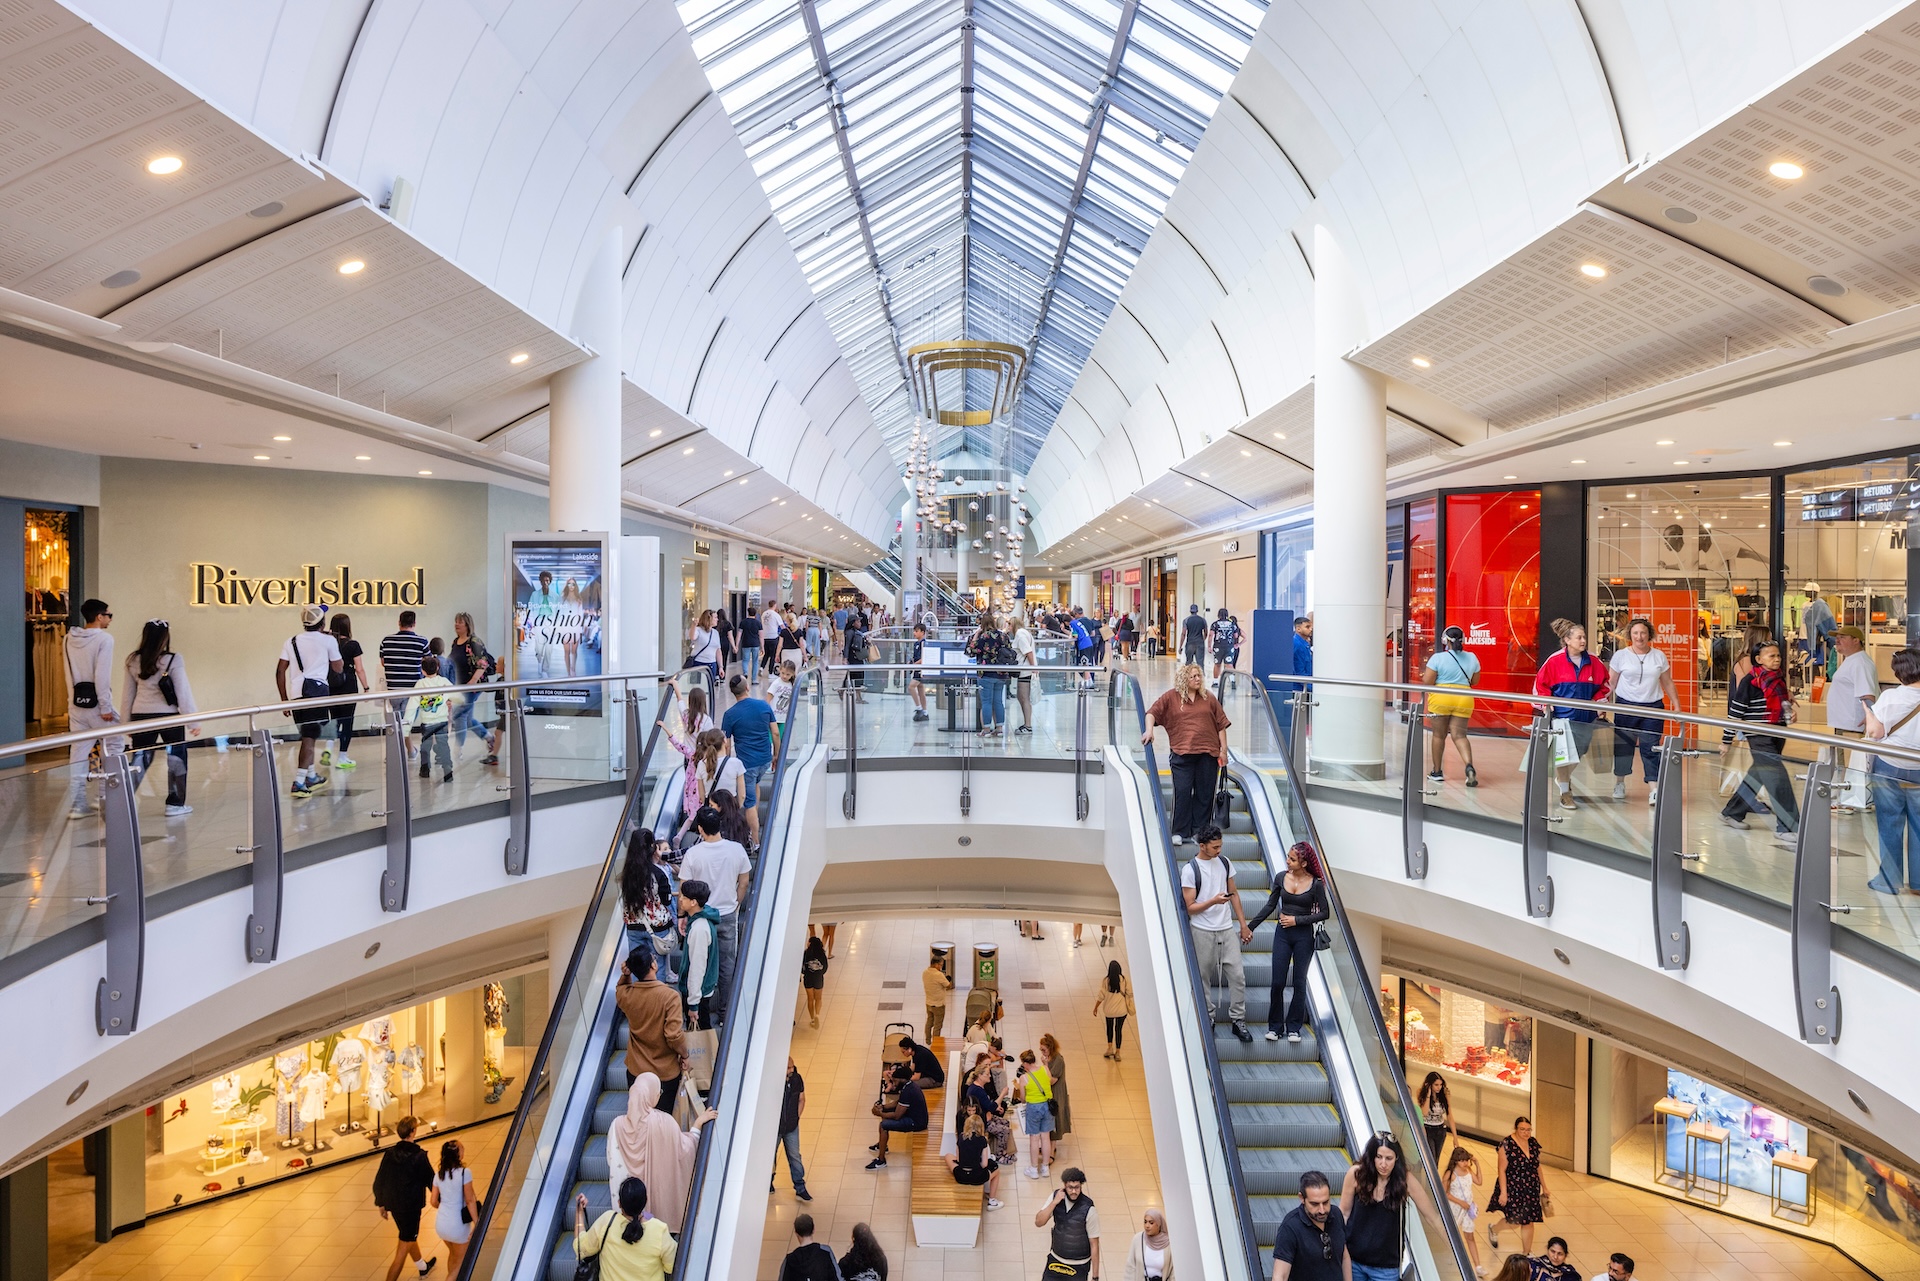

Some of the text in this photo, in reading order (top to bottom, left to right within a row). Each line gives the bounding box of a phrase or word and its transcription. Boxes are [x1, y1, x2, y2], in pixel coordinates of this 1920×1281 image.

[1863, 485, 1893, 497] RETURNS
[572, 553, 599, 561] Lakeside
[523, 609, 594, 628] Fashion
[1658, 624, 1676, 633] OFF
[541, 627, 584, 645] Show
[1469, 629, 1491, 638] UNITE
[1464, 637, 1497, 645] LAKESIDE
